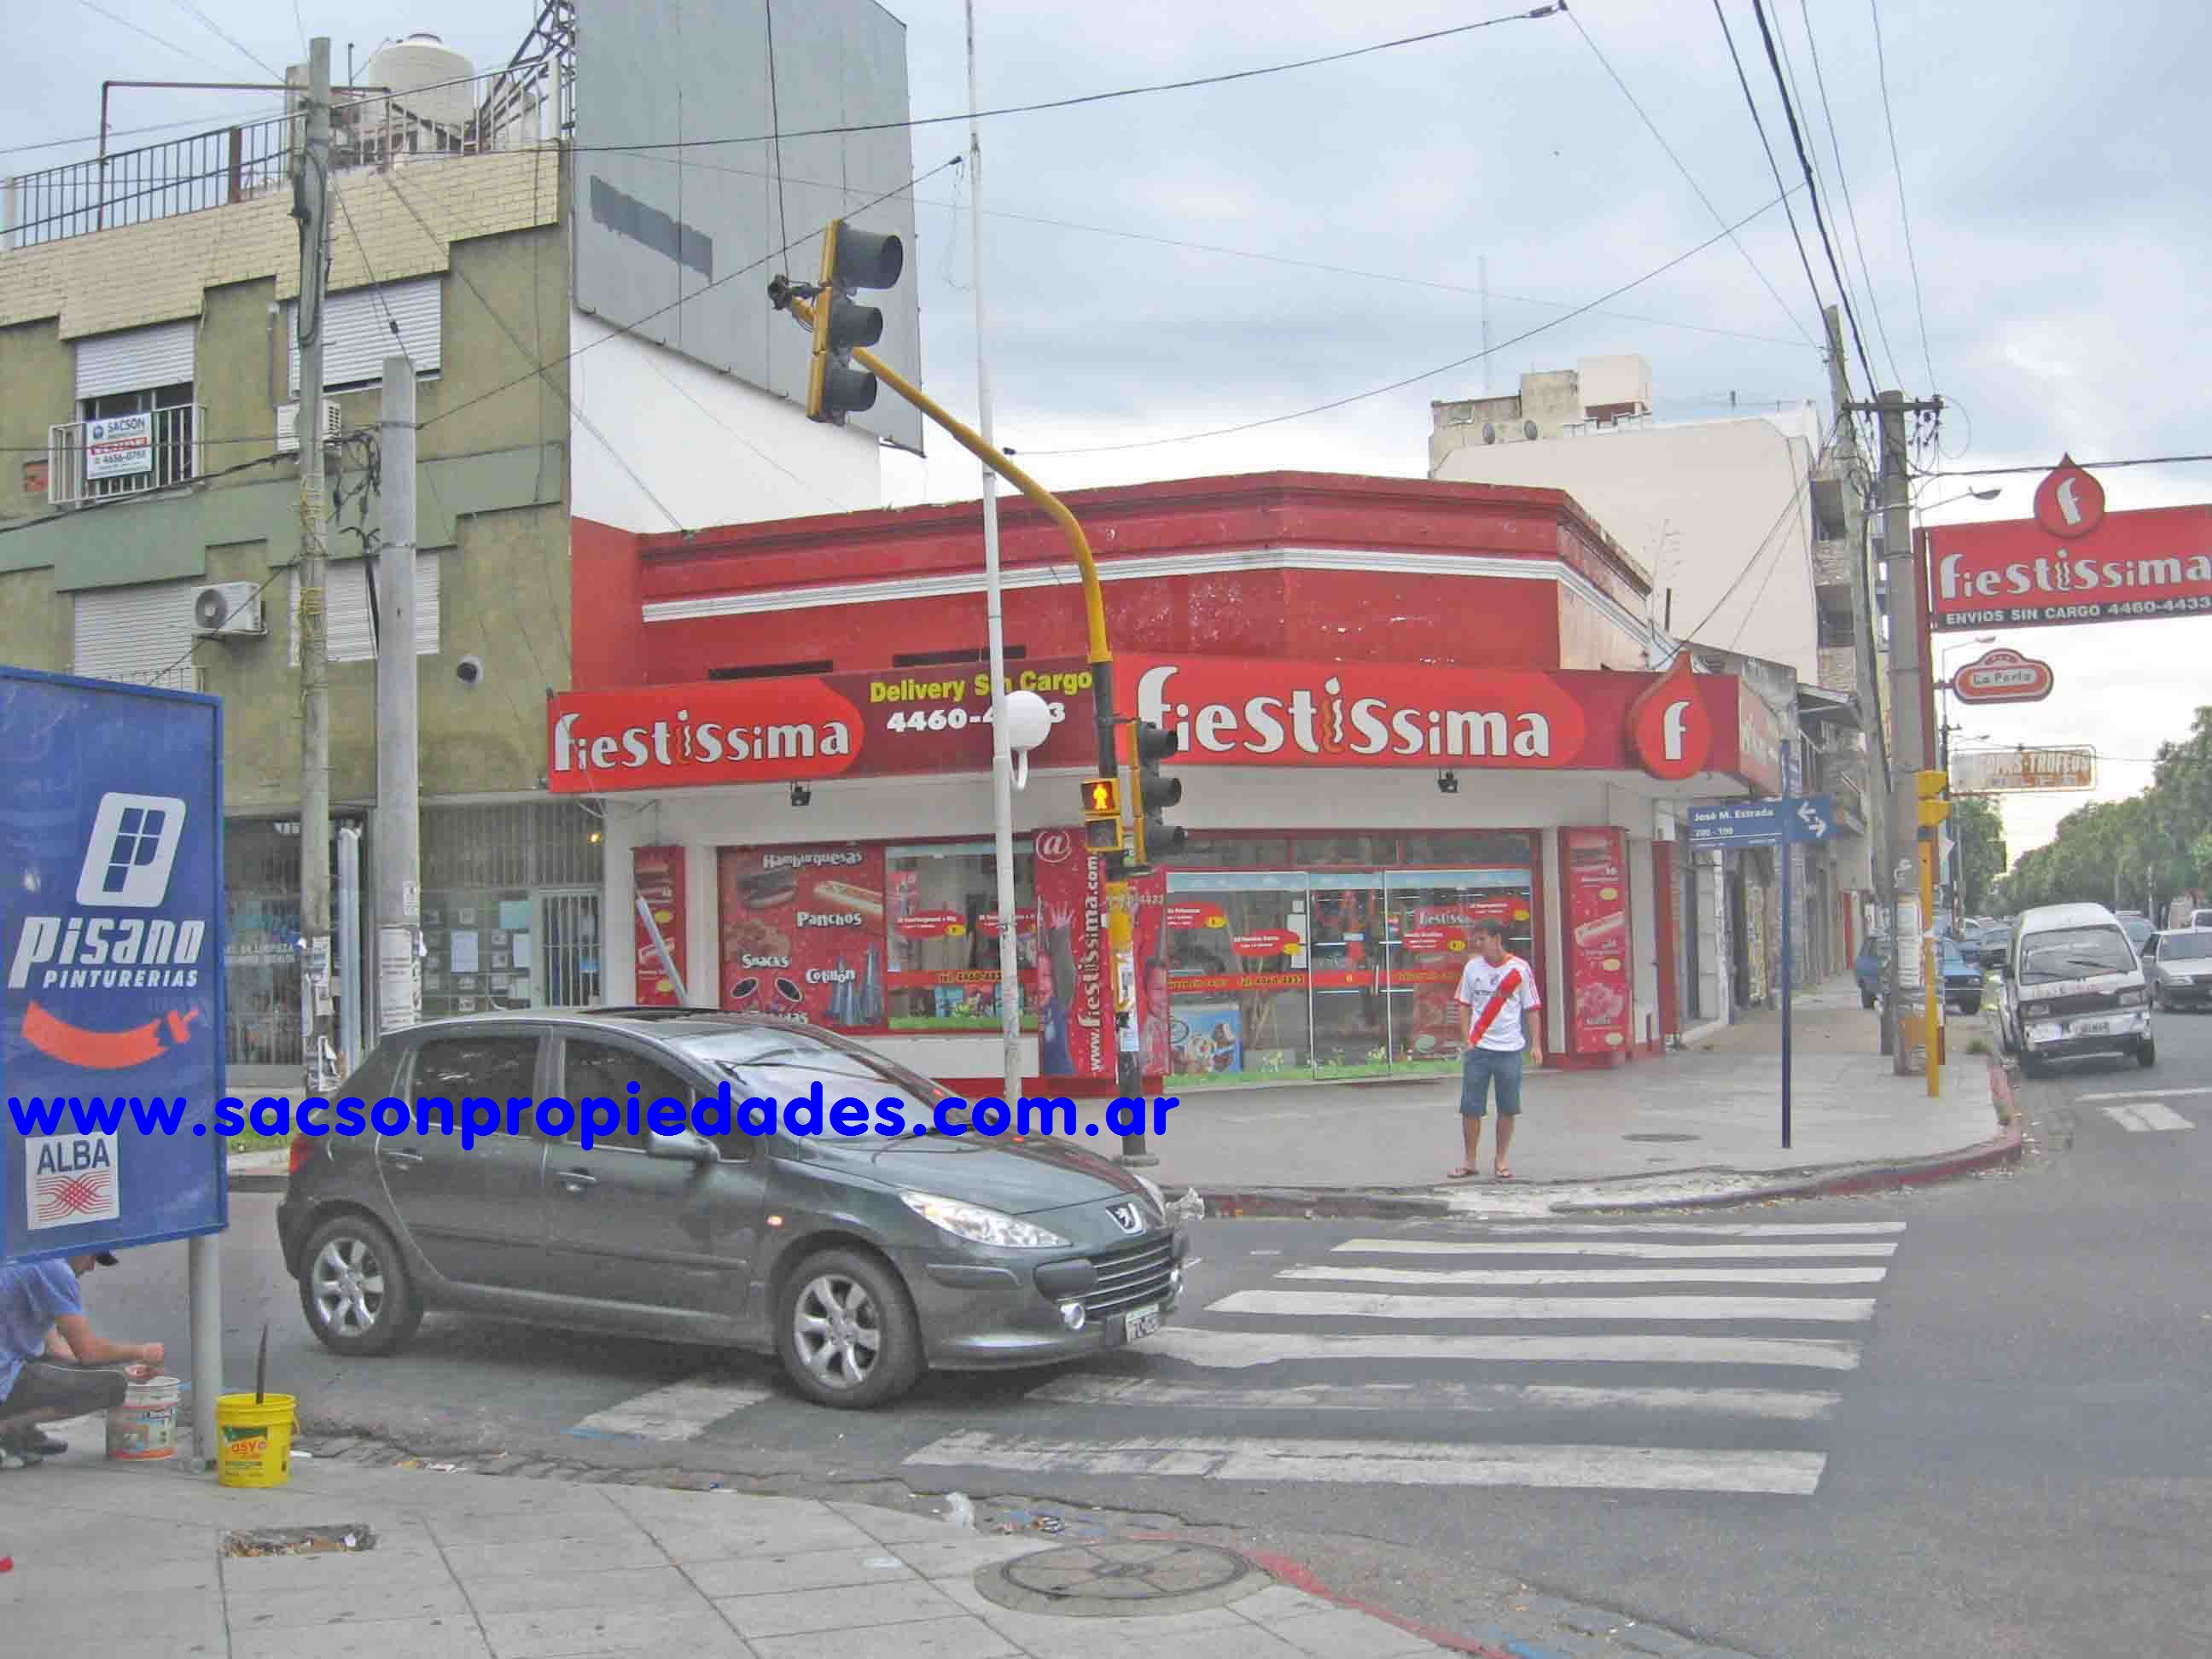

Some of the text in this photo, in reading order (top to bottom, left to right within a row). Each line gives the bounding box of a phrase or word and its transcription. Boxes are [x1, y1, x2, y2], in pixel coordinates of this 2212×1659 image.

[108, 417, 145, 431] SACSON
[1939, 548, 2212, 601] fiestissima
[1946, 596, 2212, 626] ENVIOS SIN CARGO 4460-4433
[870, 670, 1093, 703] Delivery Sn Cargo
[886, 701, 1066, 733] 4460-43
[1138, 665, 1551, 758] fiestissima
[554, 709, 850, 772] fiestissima
[1664, 701, 1692, 760] f
[1693, 807, 1775, 823] José M. Estrada
[763, 851, 862, 868] Hamburguesas
[796, 911, 862, 928] Panchos
[742, 953, 790, 969] Snacks
[42, 969, 199, 990] PINTURERIAS
[37, 1138, 111, 1176] ALBA
